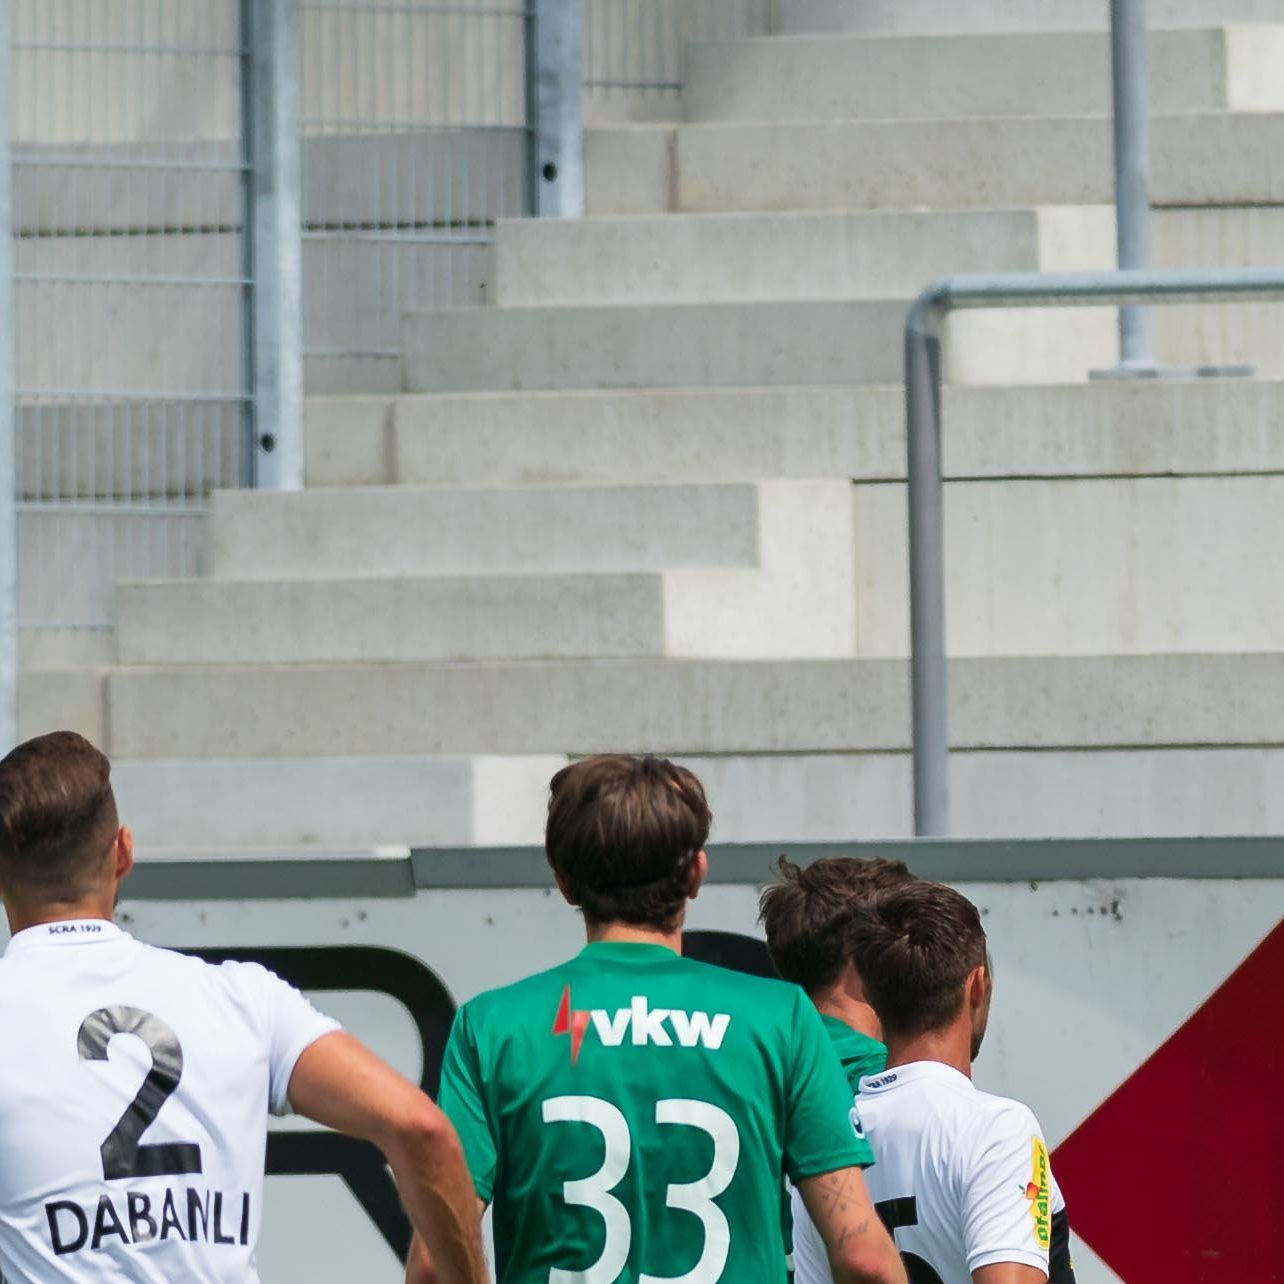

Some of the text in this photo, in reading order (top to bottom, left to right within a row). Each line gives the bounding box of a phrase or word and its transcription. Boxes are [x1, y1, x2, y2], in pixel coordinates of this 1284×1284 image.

[591, 996, 731, 1050] vkw
[77, 1004, 204, 1182] 2
[45, 1187, 250, 1256] DABANLI
